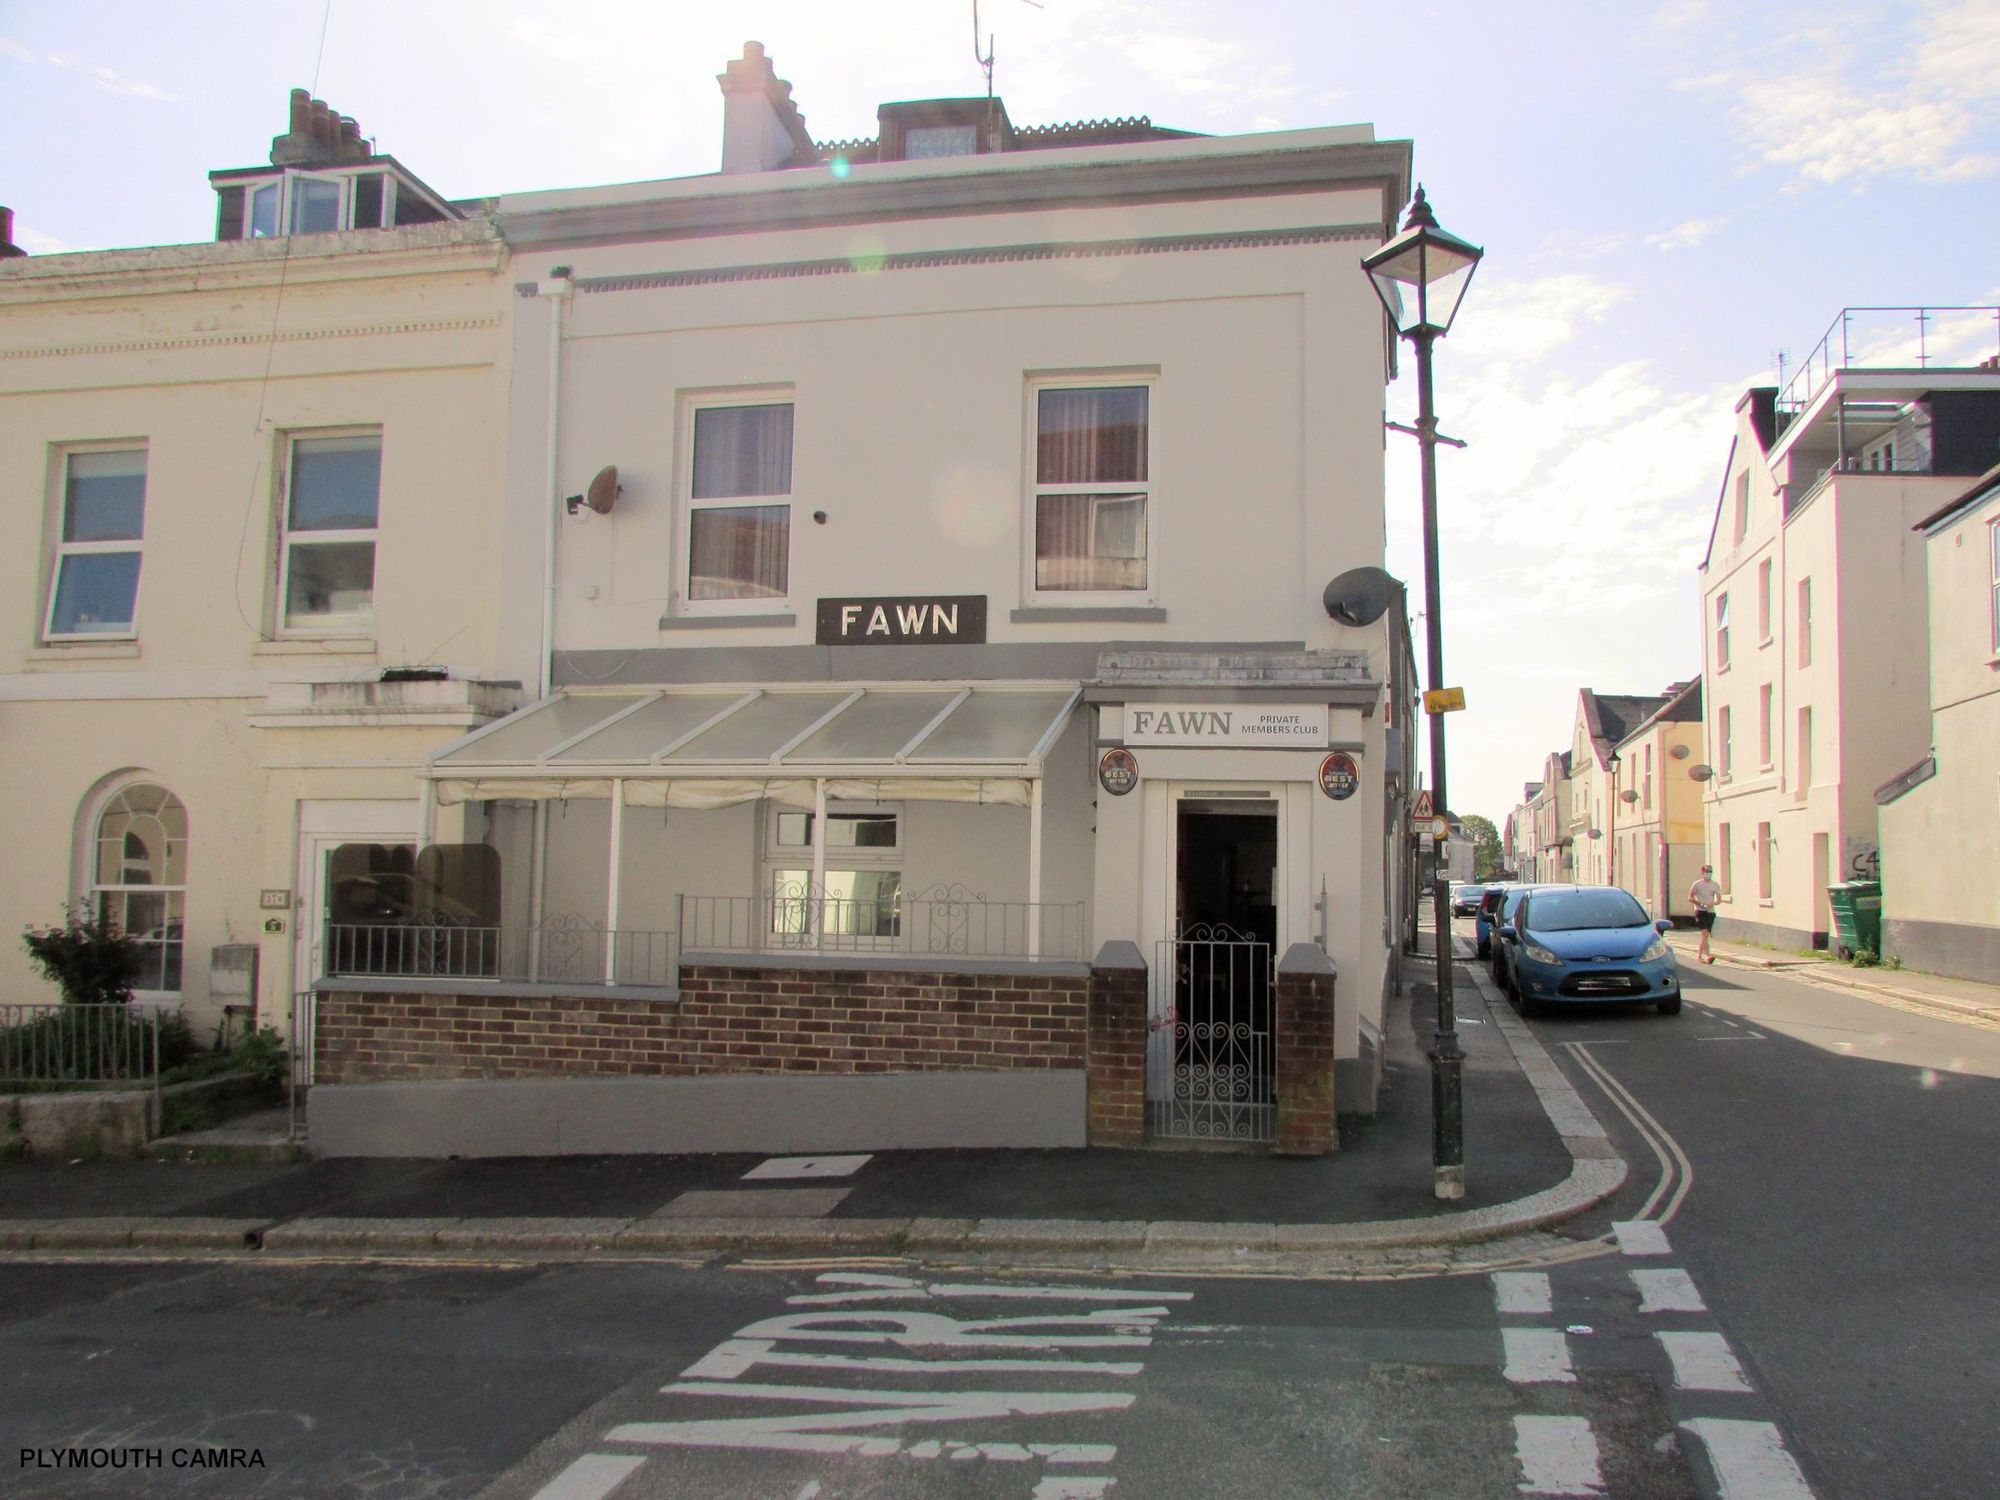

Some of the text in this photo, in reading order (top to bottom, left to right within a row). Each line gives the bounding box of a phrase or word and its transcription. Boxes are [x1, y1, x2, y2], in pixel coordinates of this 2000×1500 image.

[841, 604, 958, 635] FAWN
[1133, 711, 1233, 735] FAWN
[1260, 715, 1300, 724] PRIVATE
[1241, 725, 1319, 734] MEMBERS CLUB
